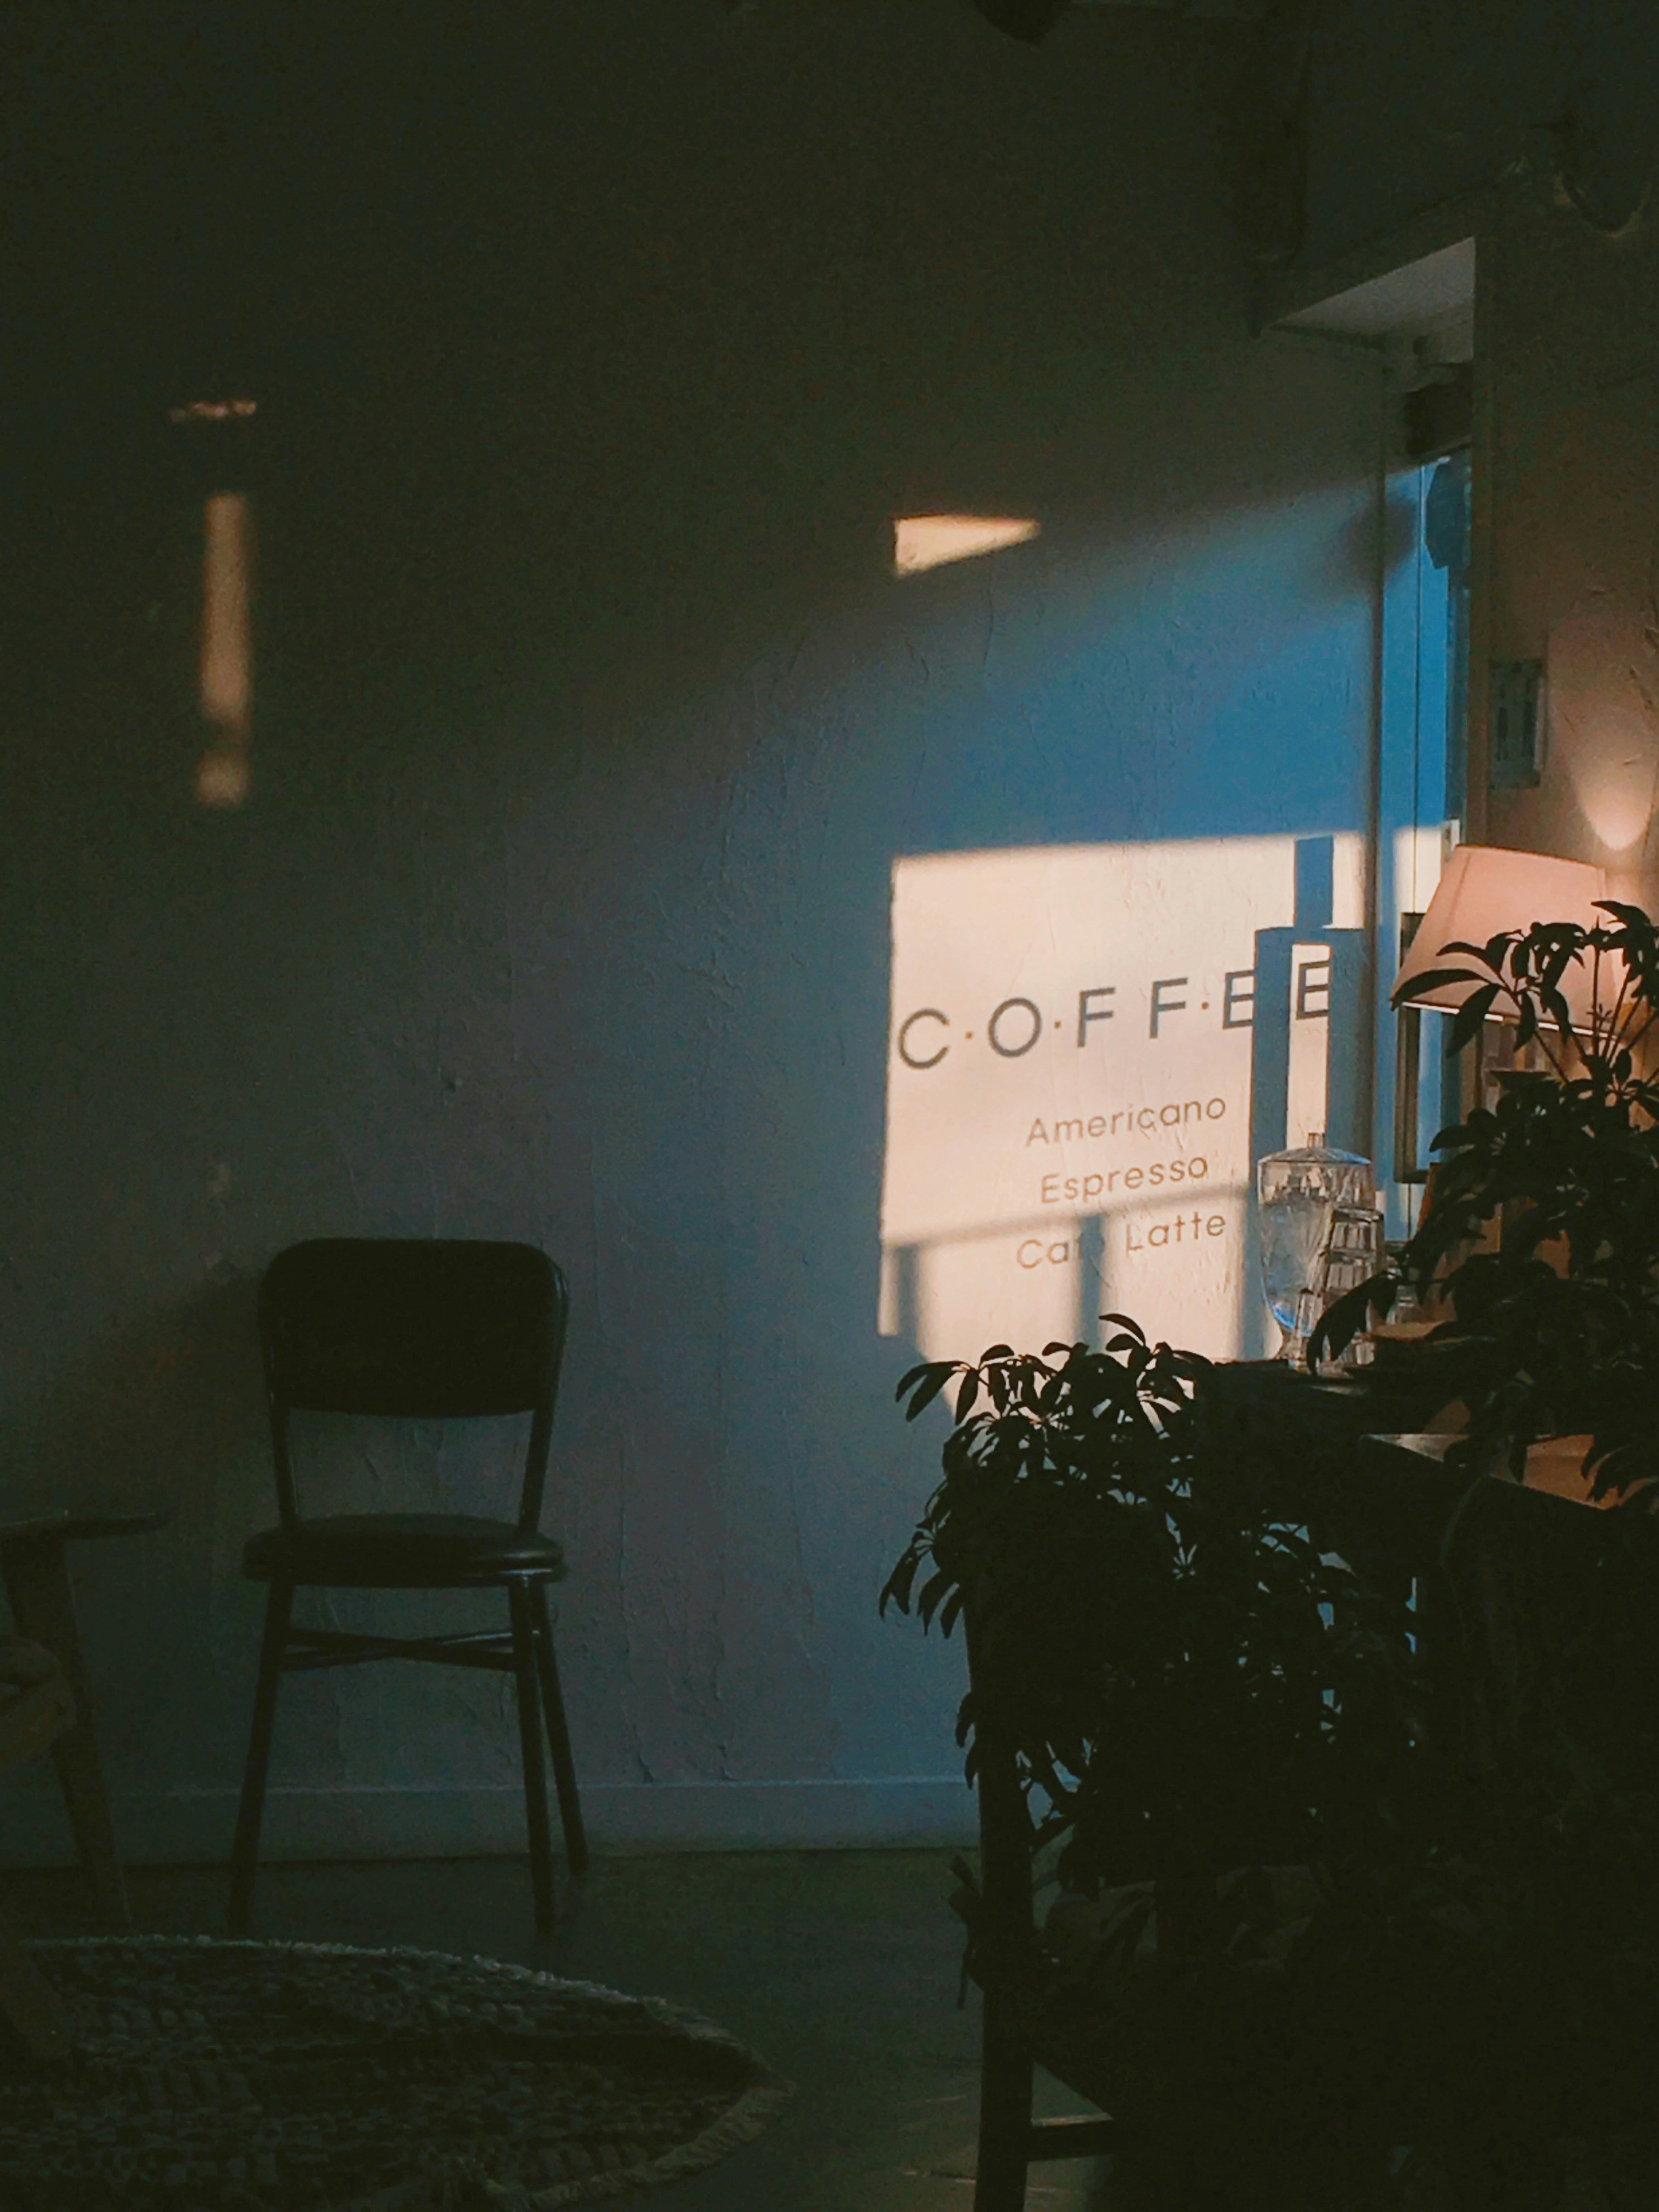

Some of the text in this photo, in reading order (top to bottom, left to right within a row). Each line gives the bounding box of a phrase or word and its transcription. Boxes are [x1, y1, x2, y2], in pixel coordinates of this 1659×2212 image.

[1025, 1098, 1226, 1147] Americano
[1040, 1156, 1208, 1204] Espresso
[1126, 1211, 1226, 1252] Latte
